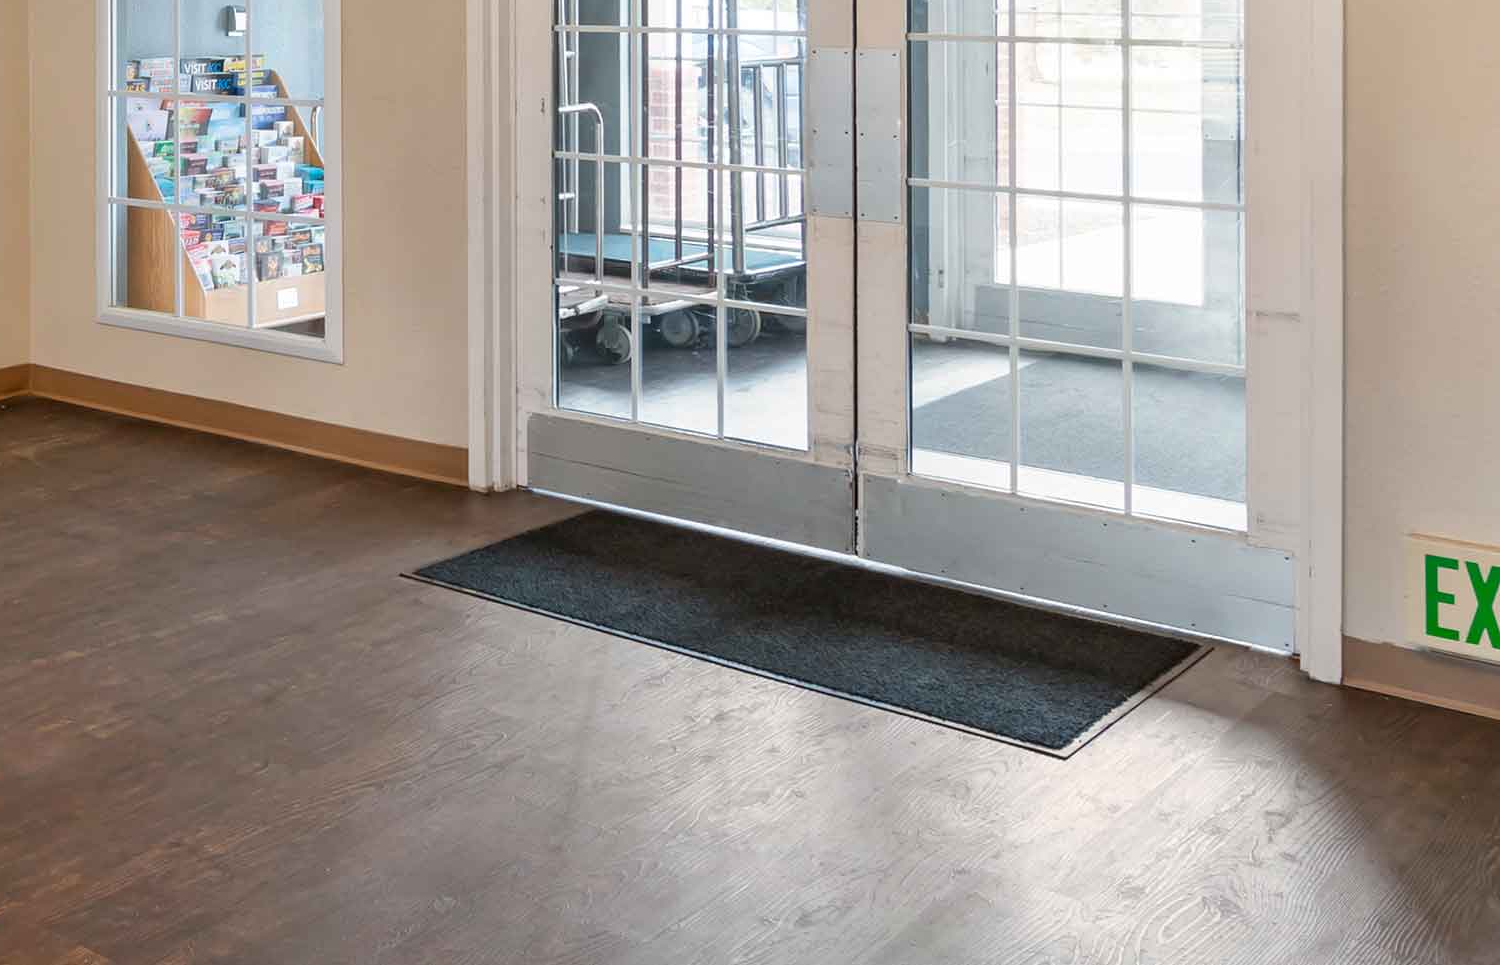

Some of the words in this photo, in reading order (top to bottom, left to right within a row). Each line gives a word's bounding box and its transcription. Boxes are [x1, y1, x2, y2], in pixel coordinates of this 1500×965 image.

[184, 62, 206, 74] VISIT
[195, 79, 217, 91] VISIT
[218, 78, 232, 90] KC
